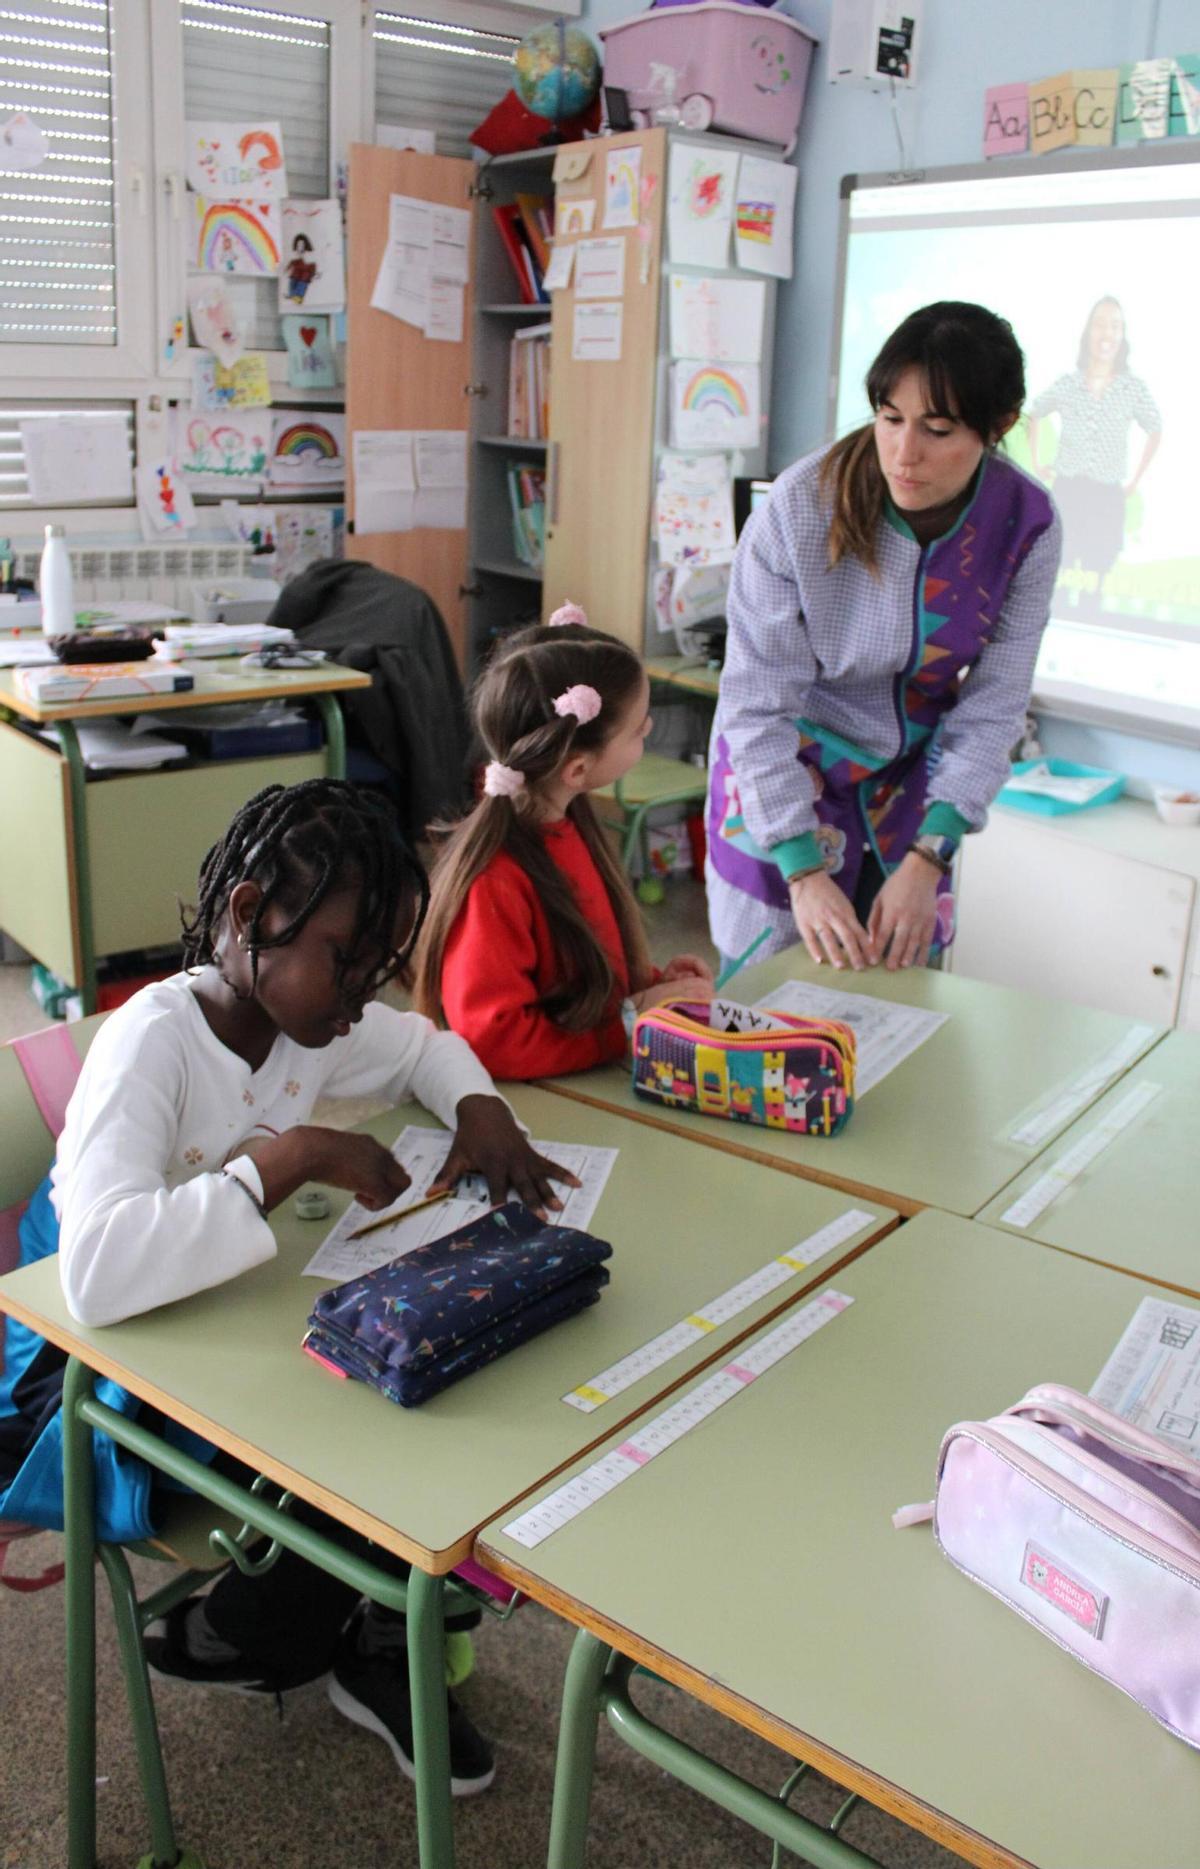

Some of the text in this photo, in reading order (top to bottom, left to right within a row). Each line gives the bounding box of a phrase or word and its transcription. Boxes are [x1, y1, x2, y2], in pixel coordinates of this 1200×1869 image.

[984, 102, 1027, 142] Aa
[1032, 95, 1071, 138] Bb
[1073, 88, 1109, 129] Cc
